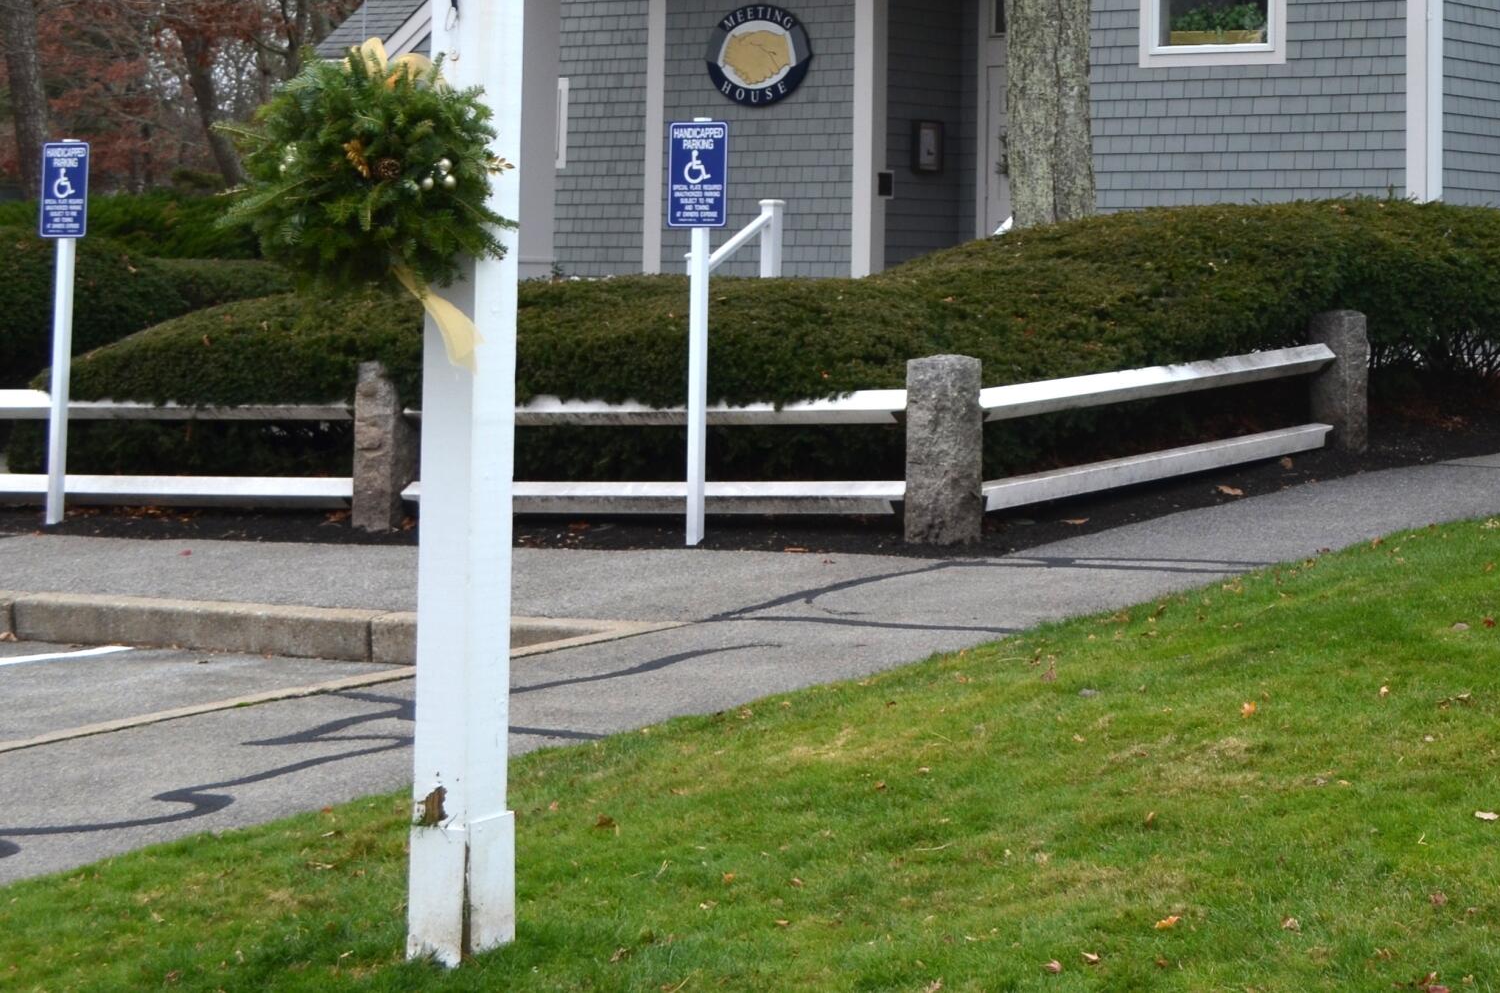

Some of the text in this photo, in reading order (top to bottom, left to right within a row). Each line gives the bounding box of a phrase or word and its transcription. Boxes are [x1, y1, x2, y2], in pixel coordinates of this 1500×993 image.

[724, 7, 794, 30] MEETING
[721, 81, 787, 103] HOUSE
[673, 127, 723, 138] HANDICAPPED
[683, 139, 714, 150] PARKING
